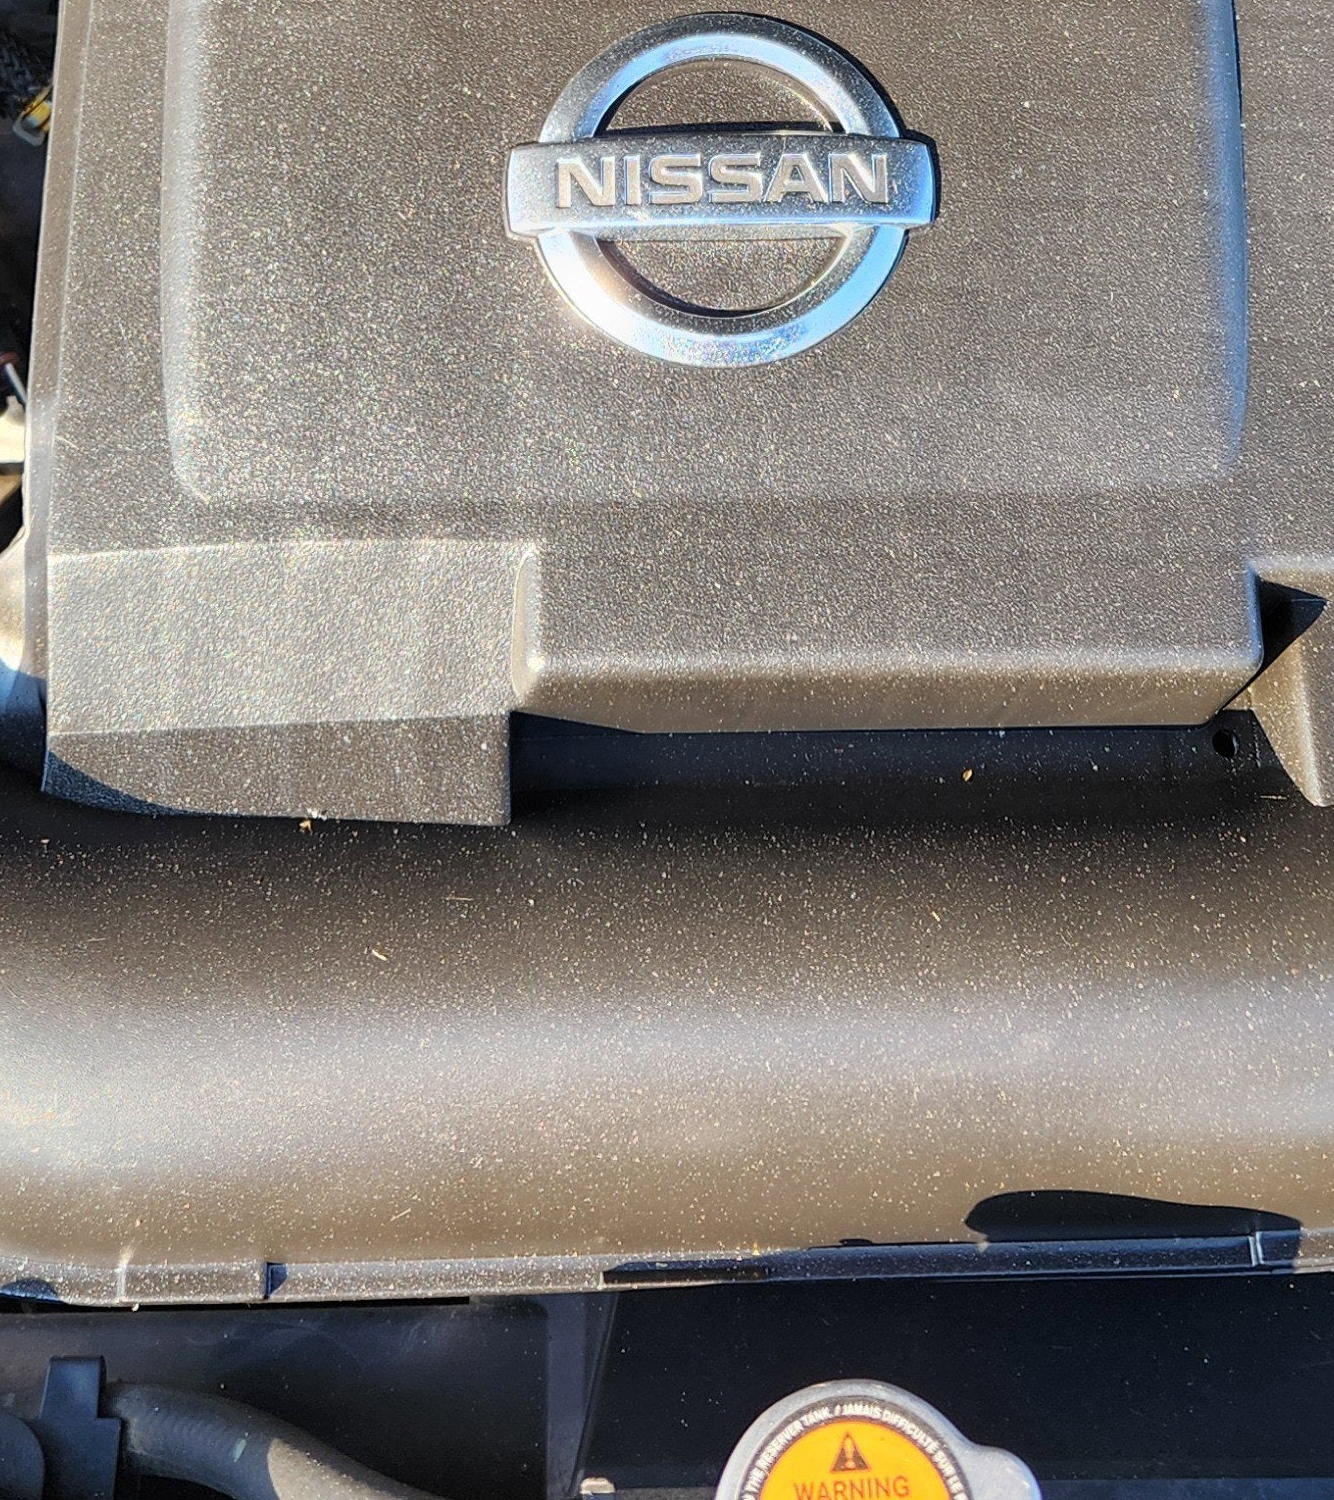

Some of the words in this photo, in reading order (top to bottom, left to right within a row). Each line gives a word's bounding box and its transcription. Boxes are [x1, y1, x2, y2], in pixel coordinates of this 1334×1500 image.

[555, 152, 891, 209] NISSAN
[841, 1404, 883, 1420] JAMAIS
[793, 1474, 910, 1500] WARNING
